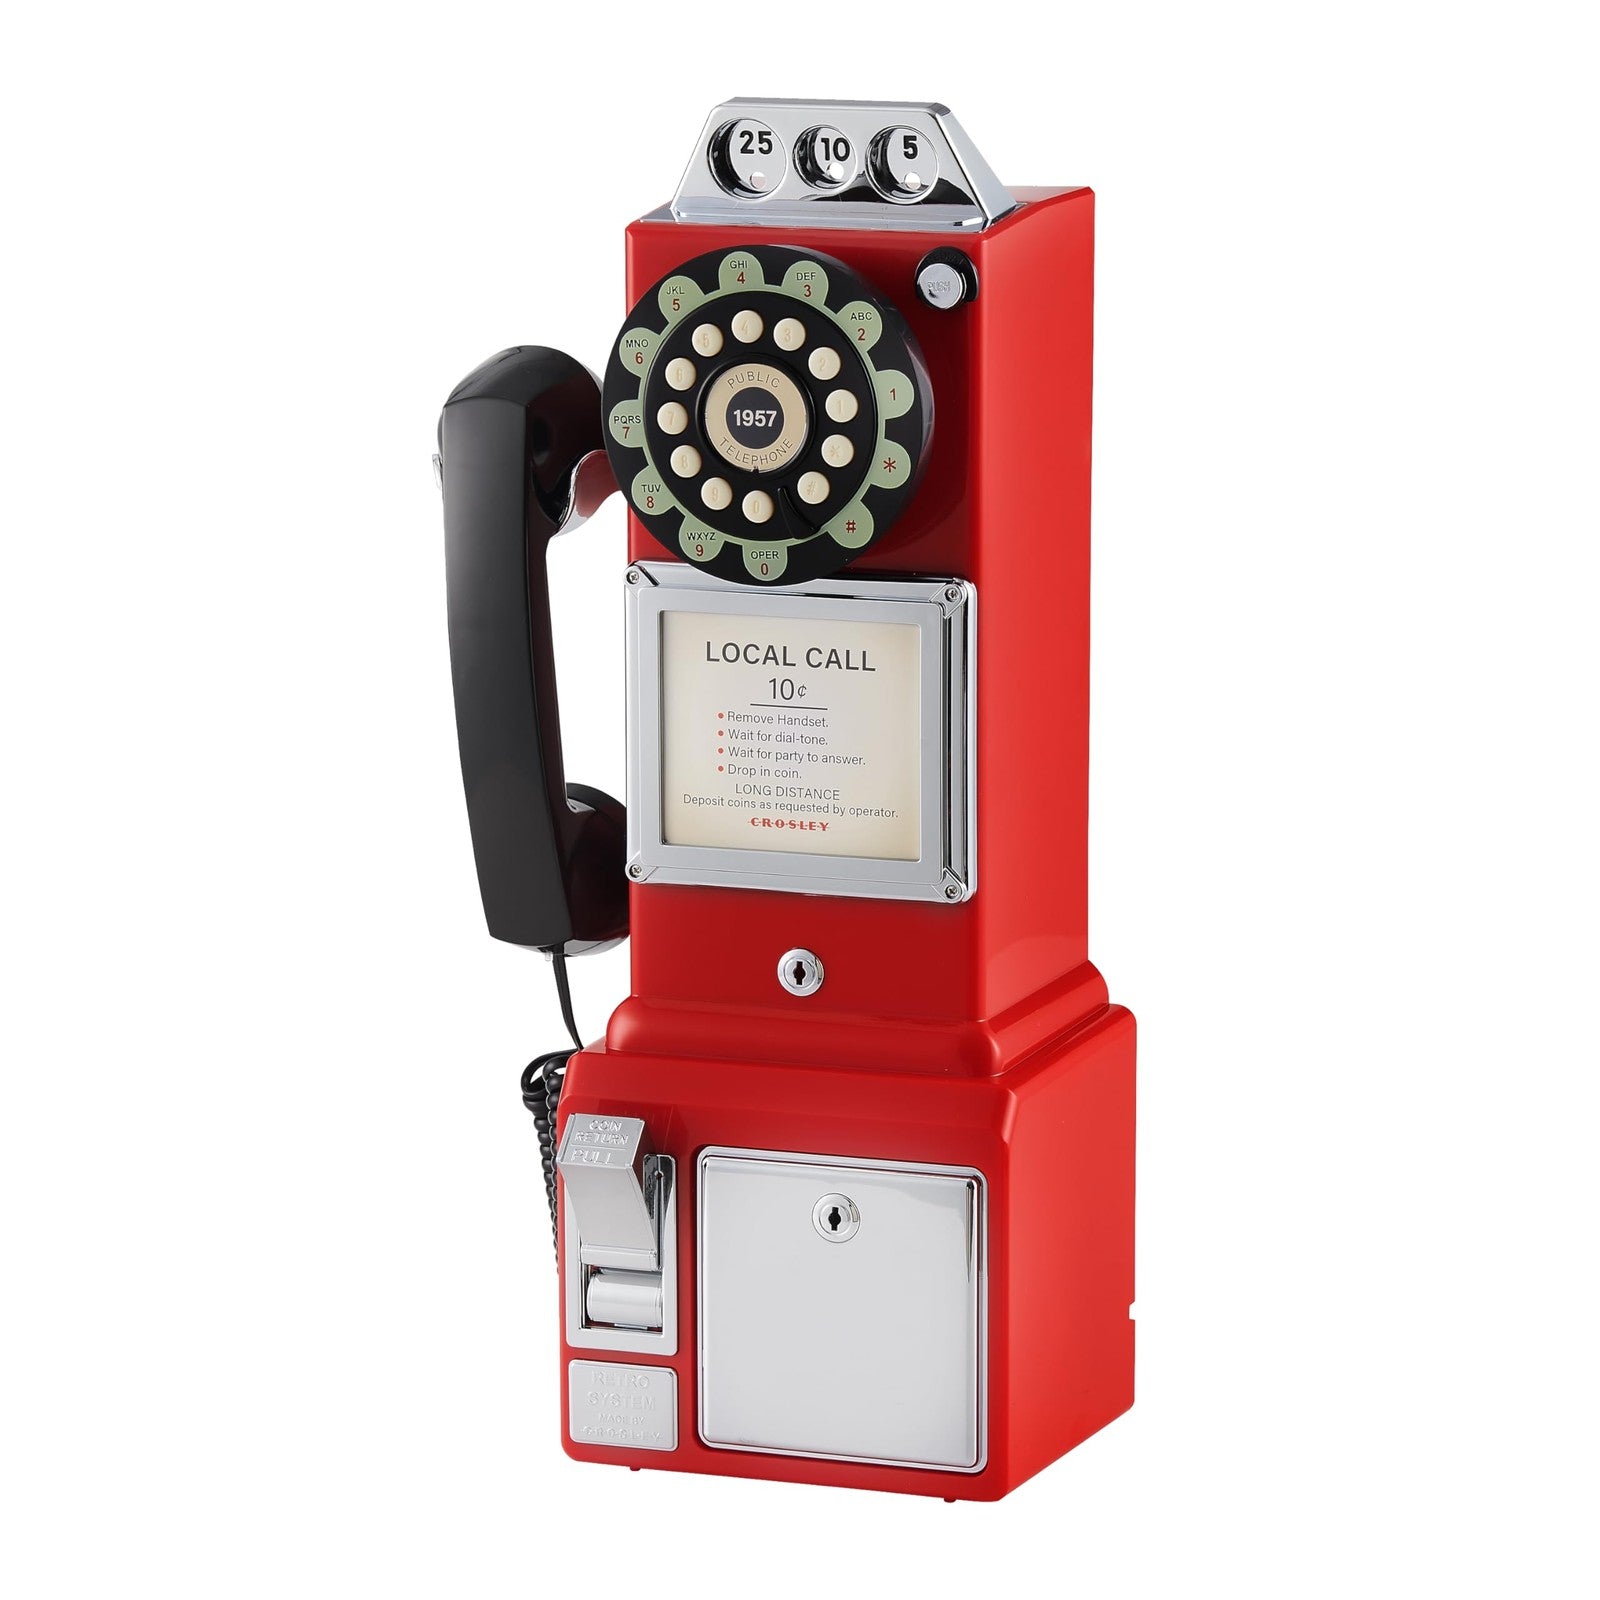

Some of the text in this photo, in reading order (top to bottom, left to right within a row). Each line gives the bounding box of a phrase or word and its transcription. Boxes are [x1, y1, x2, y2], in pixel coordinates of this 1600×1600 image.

[739, 131, 918, 162] 25 10 5
[730, 260, 748, 269] GHI
[736, 272, 746, 284] 4
[796, 272, 816, 281] DEF
[666, 286, 685, 295] JKL
[803, 285, 812, 297] 3
[672, 298, 680, 310] 5
[850, 311, 872, 321] ABC
[857, 328, 866, 340] 2
[626, 339, 649, 348] MNO
[635, 352, 644, 364] 6
[727, 371, 780, 389] PUBLIC
[890, 388, 897, 400] 1
[613, 415, 642, 425] PQRS
[733, 410, 777, 427] 1957
[622, 427, 630, 438] 7
[720, 437, 793, 465] TELEPHONE
[641, 484, 661, 493] TUV
[646, 496, 654, 508] 8
[686, 532, 716, 541] WXYZ
[695, 544, 704, 556] 9
[750, 550, 779, 560] OPER
[760, 564, 769, 576] 0
[706, 641, 876, 672] LOCAL CALL
[768, 678, 807, 701] 10¢
[728, 711, 829, 728] Remove Handset.
[728, 729, 828, 746] Wait for dial-tone.
[728, 746, 866, 766] Wait for party to answer.
[728, 764, 802, 779] Drop in coin.
[735, 784, 840, 800] LONG DISTANCE
[683, 794, 899, 818] Deposit coins as requested by operator.
[589, 1120, 622, 1132] COIN
[575, 1131, 629, 1145] RETURN
[571, 1149, 613, 1165] PULL
[592, 1370, 650, 1390] RETRO
[587, 1391, 656, 1411] SYSTEM
